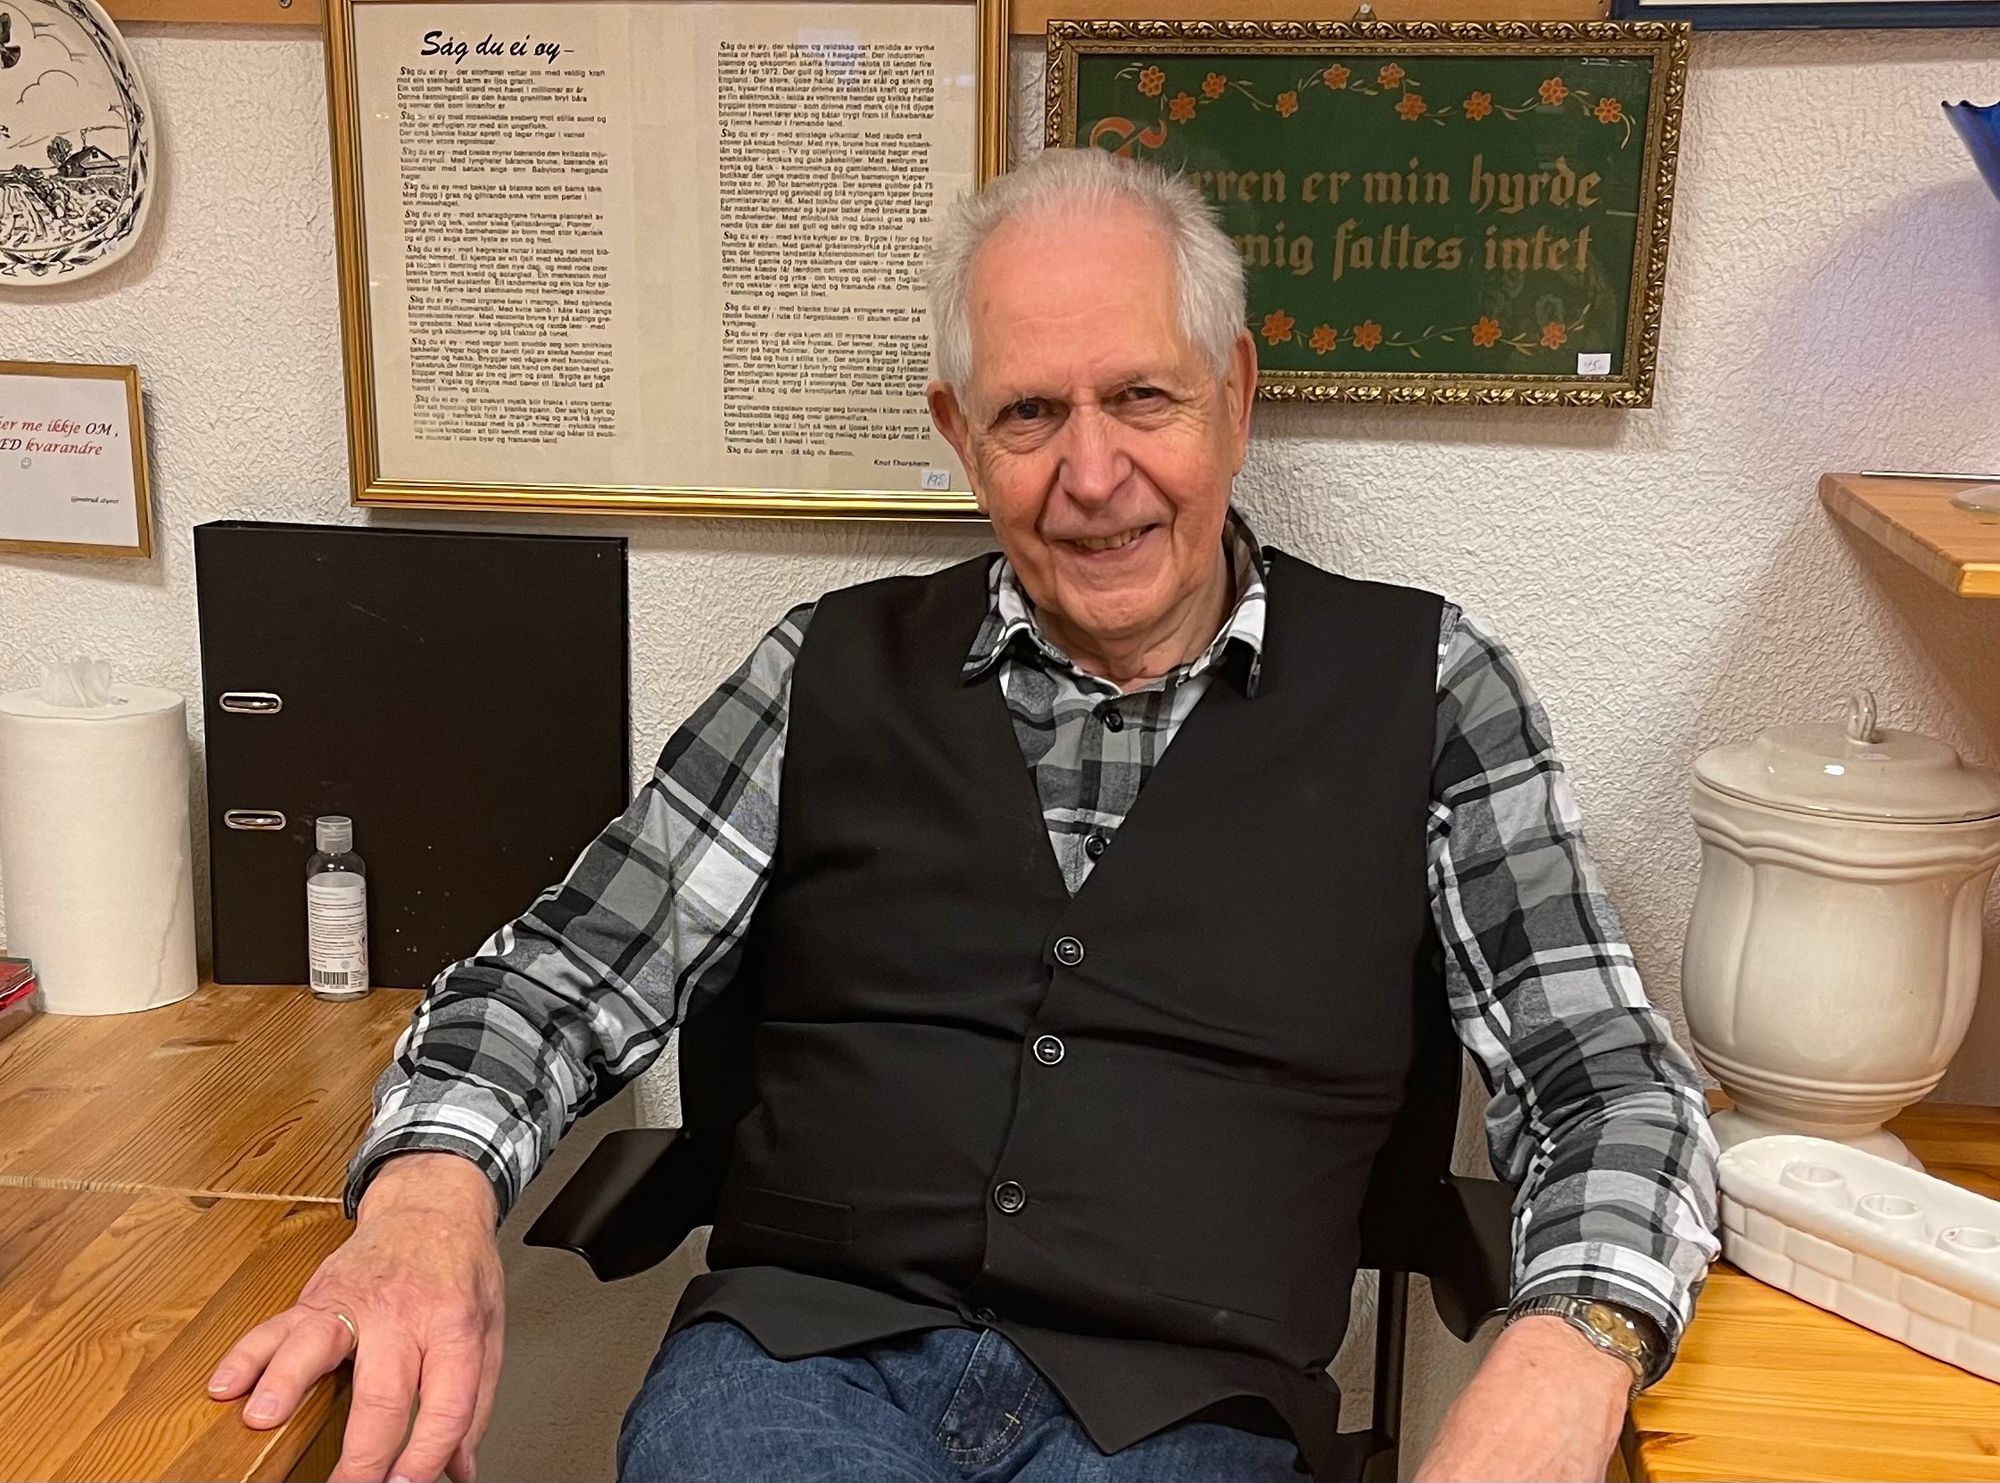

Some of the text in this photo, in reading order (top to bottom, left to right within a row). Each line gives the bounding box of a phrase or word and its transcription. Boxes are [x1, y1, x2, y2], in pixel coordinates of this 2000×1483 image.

[420, 30, 469, 64] Såg
[475, 33, 505, 56] du
[510, 34, 530, 56] ei
[533, 42, 560, 64] øy
[1302, 171, 1351, 205] er
[1362, 156, 1450, 205] min
[1469, 153, 1601, 215] hyrde
[1232, 217, 1593, 282] mig fattes intet
[0, 416, 18, 431] er
[21, 421, 43, 432] me
[47, 419, 81, 437] ikkje
[0, 438, 103, 455] ED kvarandre
